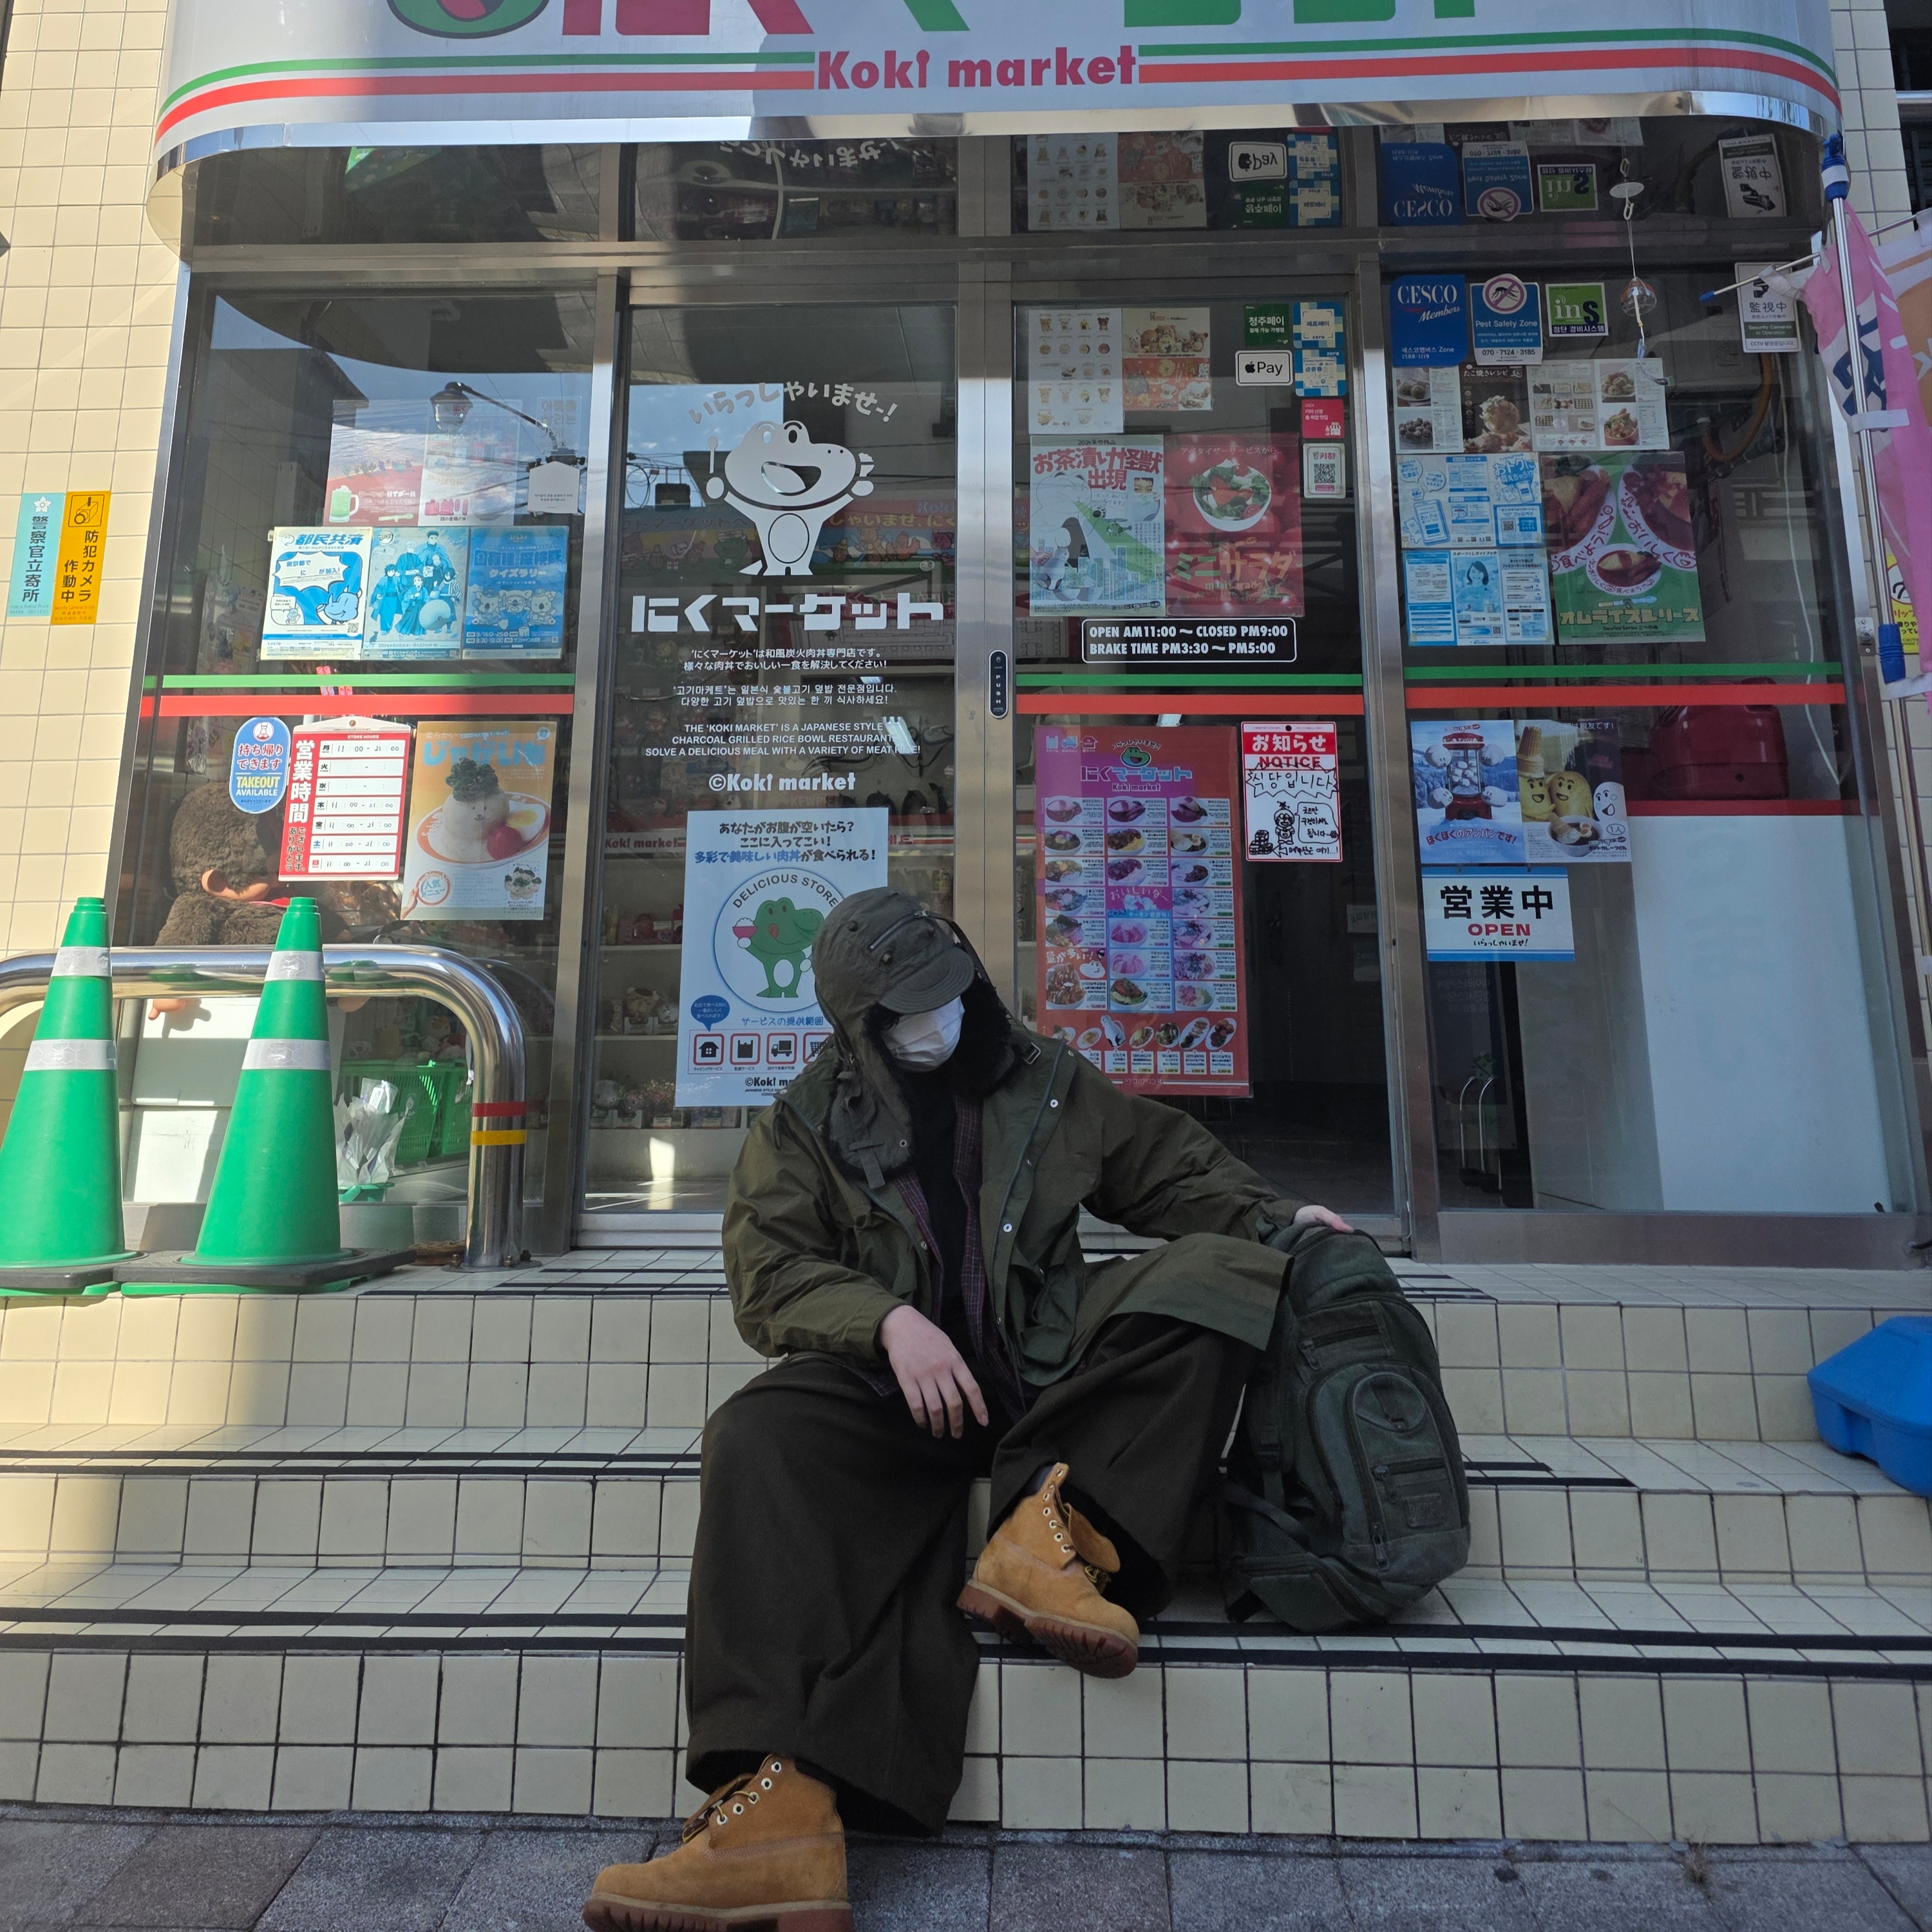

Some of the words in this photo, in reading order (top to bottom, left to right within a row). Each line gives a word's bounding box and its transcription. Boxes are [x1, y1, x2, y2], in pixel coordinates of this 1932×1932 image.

[817, 49, 929, 90] Koki
[948, 46, 1137, 88] market
[1397, 284, 1457, 305] CESCO
[1749, 301, 1787, 313] 監視中
[1419, 305, 1461, 323] Members
[1248, 316, 1285, 327] 청주페이
[1493, 320, 1517, 328] Safety
[1553, 325, 1567, 334] 첨단
[1569, 325, 1605, 334] 경비시스템
[1256, 361, 1283, 376] Pay
[1463, 368, 1508, 377] たこ焼きレシピ
[1493, 458, 1536, 476] おトクに
[1087, 468, 1128, 491] 出現
[916, 500, 956, 513] Koki
[294, 533, 363, 546] 都民共済
[22, 516, 49, 603] 警察官立寄所
[79, 530, 100, 602] 防犯カメラ
[1174, 550, 1296, 581] ミニサラダ
[489, 569, 547, 578] クイズラリー
[61, 559, 79, 603] 作動中
[630, 592, 944, 633] にくマーケット
[1089, 626, 1120, 638] OPEN
[1123, 626, 1177, 638] AM11:00
[1196, 625, 1237, 638] CLOSED
[1240, 625, 1288, 638] PM9:00
[1089, 643, 1128, 655] BRAKE
[1131, 643, 1159, 654] TIME
[1162, 643, 1209, 654] PM3:30
[1229, 642, 1276, 654] PM5:00
[741, 685, 768, 695] 일본식
[773, 685, 811, 695] 숯불고기
[815, 685, 833, 695] 덮밥
[681, 696, 709, 706] 다양한
[713, 696, 732, 706] 고기
[736, 696, 773, 706] 덮밥으로
[778, 696, 806, 706] 맛있는
[810, 696, 820, 706] 한
[824, 696, 833, 705] 끼
[837, 695, 888, 705] 식사하세요!
[684, 724, 704, 733] THE
[781, 723, 790, 732] IS
[792, 723, 799, 732] A
[801, 723, 851, 732] JAPANESE
[853, 723, 883, 731] STYLE
[672, 735, 726, 744] CHARCOAL
[728, 735, 770, 744] GRILLED
[772, 735, 795, 744] RICE
[798, 735, 826, 744] BOWL
[1252, 734, 1327, 753] お知らせ
[238, 743, 283, 757] 持ち帰り
[645, 748, 677, 756] SOLVE
[678, 748, 686, 756] A
[688, 747, 741, 756] DELICIOUS
[743, 747, 770, 755] MEAL
[772, 746, 796, 755] WITH
[798, 746, 806, 755] A
[808, 746, 848, 755] VARIETY
[851, 746, 864, 755] OF
[866, 746, 893, 754] MEAT
[895, 745, 920, 754] RE!
[237, 758, 282, 770] できます
[1259, 756, 1321, 768] NOTICE
[1081, 766, 1193, 782] にくマーケット
[1253, 770, 1333, 790] 식당입니다
[236, 776, 281, 789] TAKEOUT
[288, 739, 316, 824] 営業時間
[779, 773, 856, 791] market
[1112, 783, 1130, 792] Koki
[1131, 783, 1161, 792] market
[719, 820, 855, 835] あなたがお腹が空いたら?
[605, 837, 630, 849] Koki
[633, 837, 678, 848] market
[740, 836, 831, 848] ここに入ってこい!
[1426, 828, 1517, 846] ほくほくのアンパンです!
[285, 828, 297, 871] ありがとう
[694, 849, 876, 864] 多彩で美味しい肉丼が食べられる!
[425, 879, 441, 890] 人気
[732, 873, 798, 909] DELICIOUS
[801, 876, 839, 907] STORE
[421, 889, 446, 898] メニュー
[1439, 884, 1553, 920] 営業中
[1468, 923, 1531, 936] OPEN
[1473, 938, 1529, 947] いらっしゃいませ!
[741, 1016, 824, 1027] サービスの提供範囲
